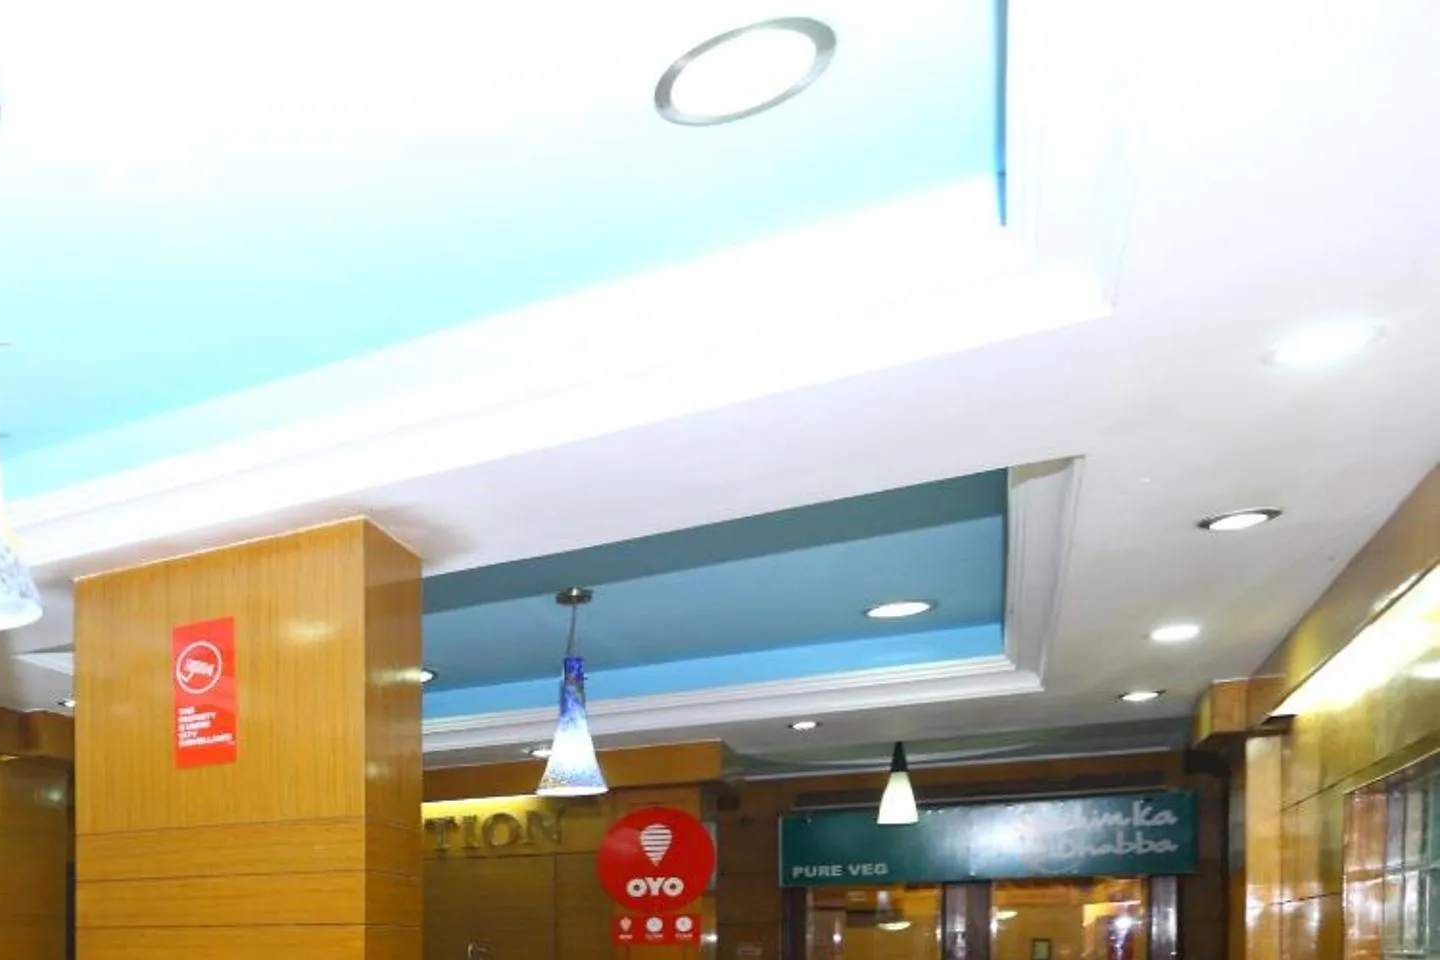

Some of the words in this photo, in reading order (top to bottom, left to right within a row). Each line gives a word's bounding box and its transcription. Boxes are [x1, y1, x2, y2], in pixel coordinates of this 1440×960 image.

[792, 865, 843, 879] PURE
[848, 862, 889, 876] VEG
[626, 876, 684, 897] OYO
